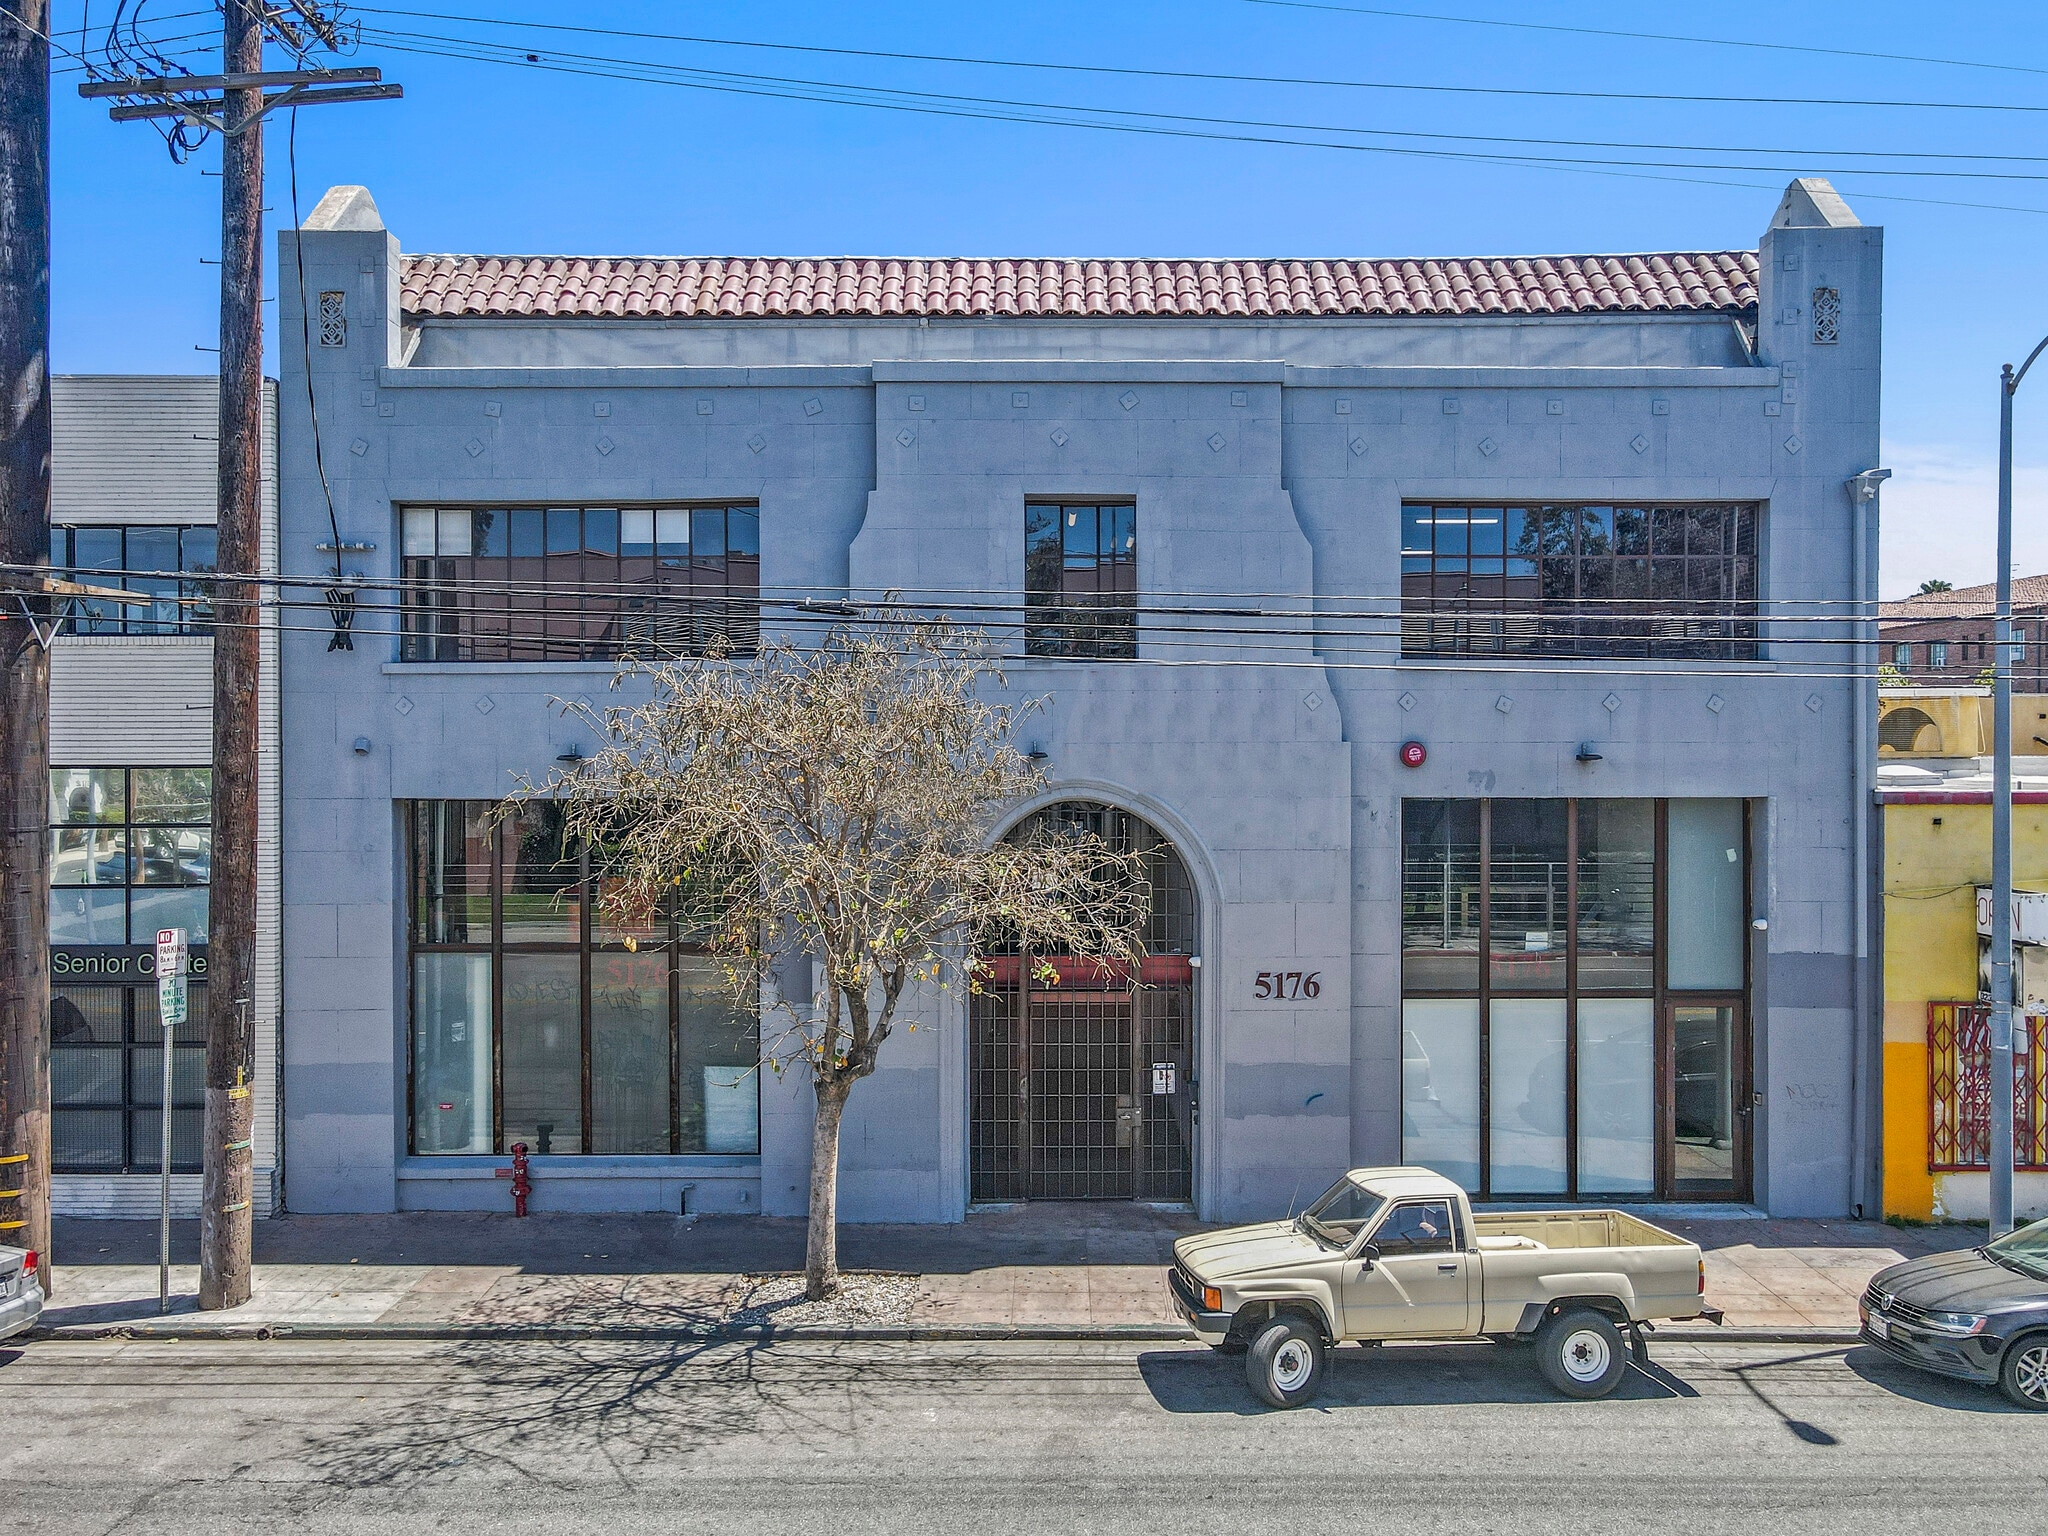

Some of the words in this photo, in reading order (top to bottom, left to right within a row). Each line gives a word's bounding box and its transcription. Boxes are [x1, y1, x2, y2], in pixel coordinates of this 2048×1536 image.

[1977, 897, 2020, 931] ON
[160, 932, 171, 942] NO
[160, 944, 185, 955] PARKING
[53, 953, 130, 974] Senior
[137, 953, 208, 974] Cte
[607, 960, 668, 985] 5176
[168, 979, 176, 988] 30
[1255, 971, 1321, 999] 5176
[162, 987, 183, 997] MINUTE
[161, 996, 185, 1007] PARKING
